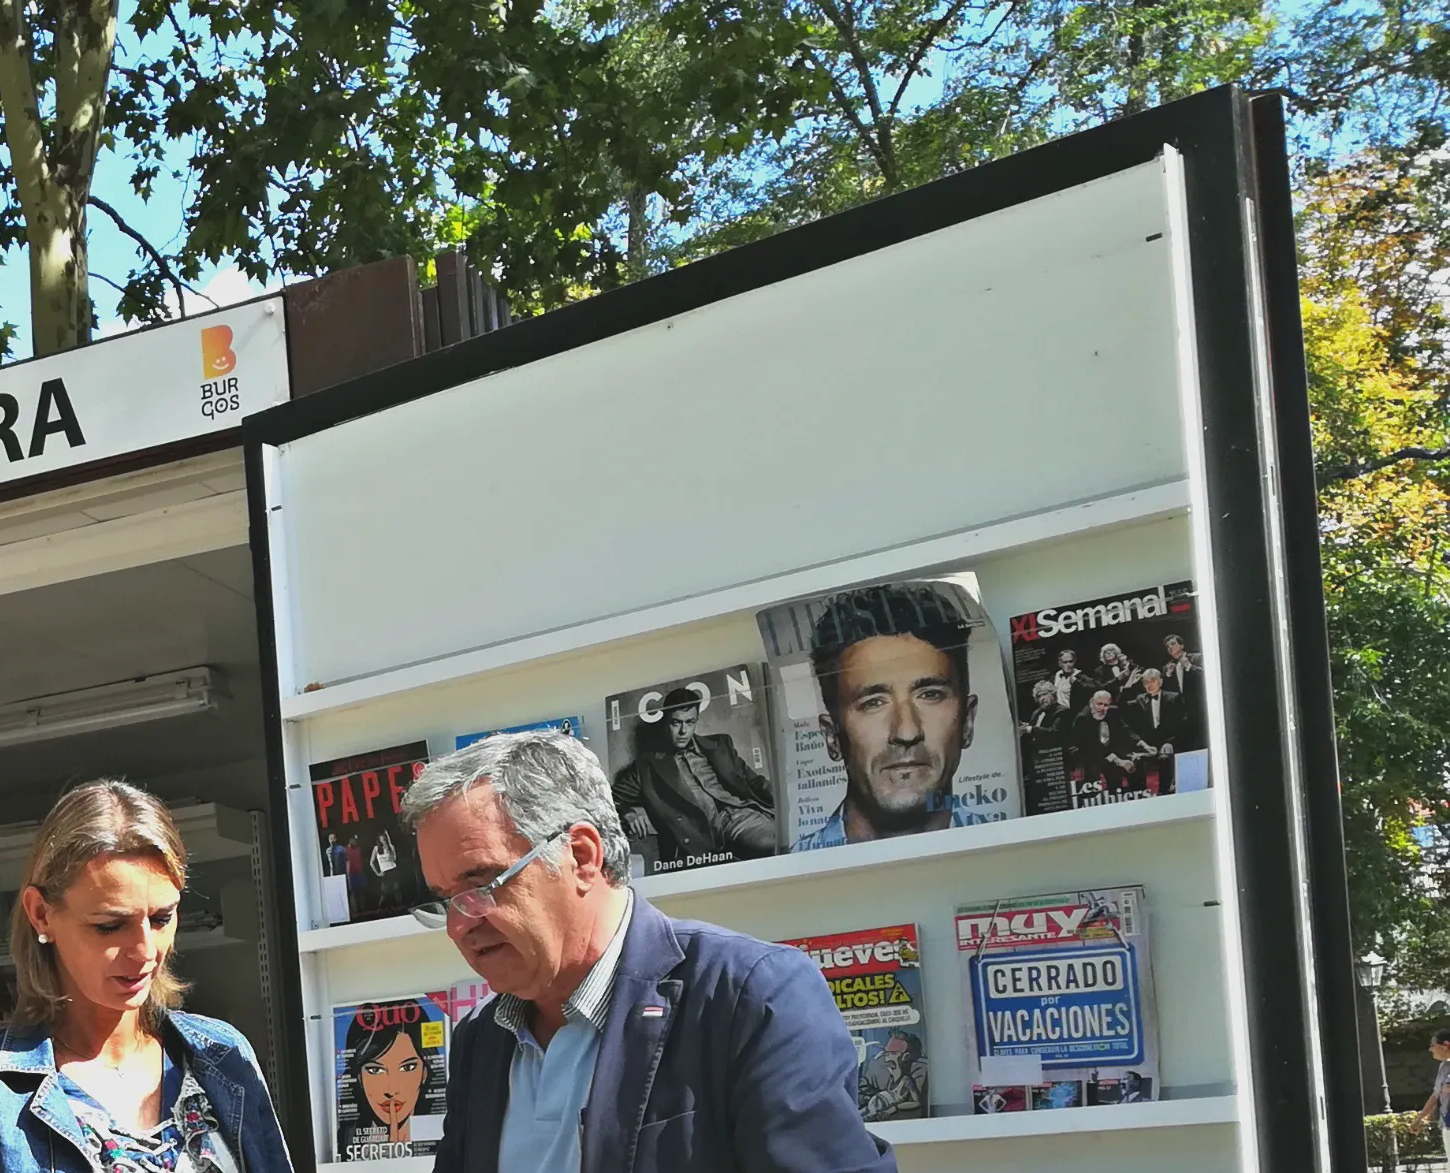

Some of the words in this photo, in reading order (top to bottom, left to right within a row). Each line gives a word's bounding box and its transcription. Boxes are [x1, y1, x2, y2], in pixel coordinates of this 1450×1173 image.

[200, 377, 239, 400] BUR
[201, 394, 240, 420] GOS
[316, 766, 406, 828] PAPE
[926, 784, 1008, 812] Eneko
[1070, 780, 1103, 796] Les
[653, 858, 683, 872] Dane
[686, 851, 733, 867] DeHaan
[958, 907, 1091, 941] muy
[959, 931, 1057, 947] INTERESANTE
[808, 938, 905, 970] ueves
[993, 960, 1118, 994] CERRADO
[836, 990, 886, 1009] LTOS!
[1040, 995, 1061, 1007] por
[356, 1002, 421, 1031] Quo
[989, 1002, 1130, 1043] VACACIONES
[353, 1136, 360, 1144] DE
[356, 1127, 363, 1136] EL
[346, 1141, 413, 1162] SECRETOS
